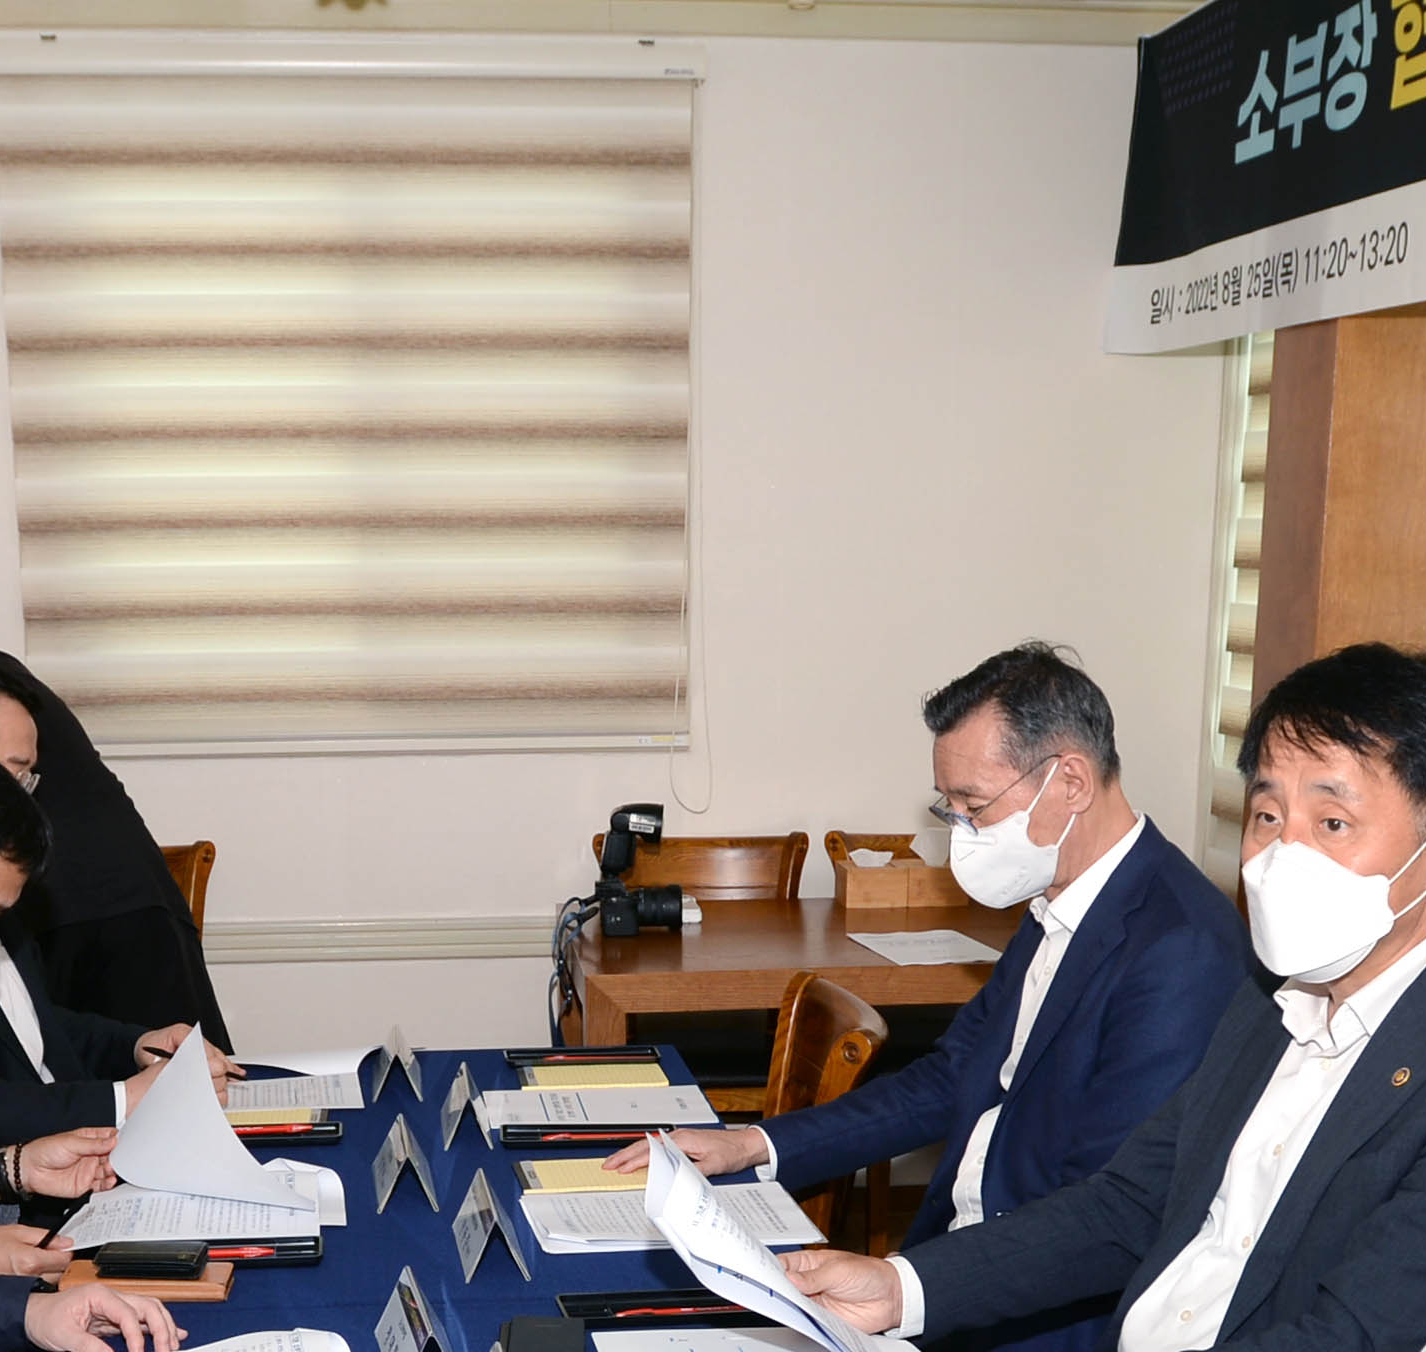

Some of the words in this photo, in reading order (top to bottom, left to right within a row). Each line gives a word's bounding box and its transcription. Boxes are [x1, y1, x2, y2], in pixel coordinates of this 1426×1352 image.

[1234, 0, 1378, 165] 소부장
[1150, 284, 1175, 324] 일시
[1185, 271, 1219, 315] 2022년
[1221, 265, 1243, 307] 8월
[1246, 246, 1299, 299] 25일(목)
[1304, 221, 1409, 285] 11:20~13:20
